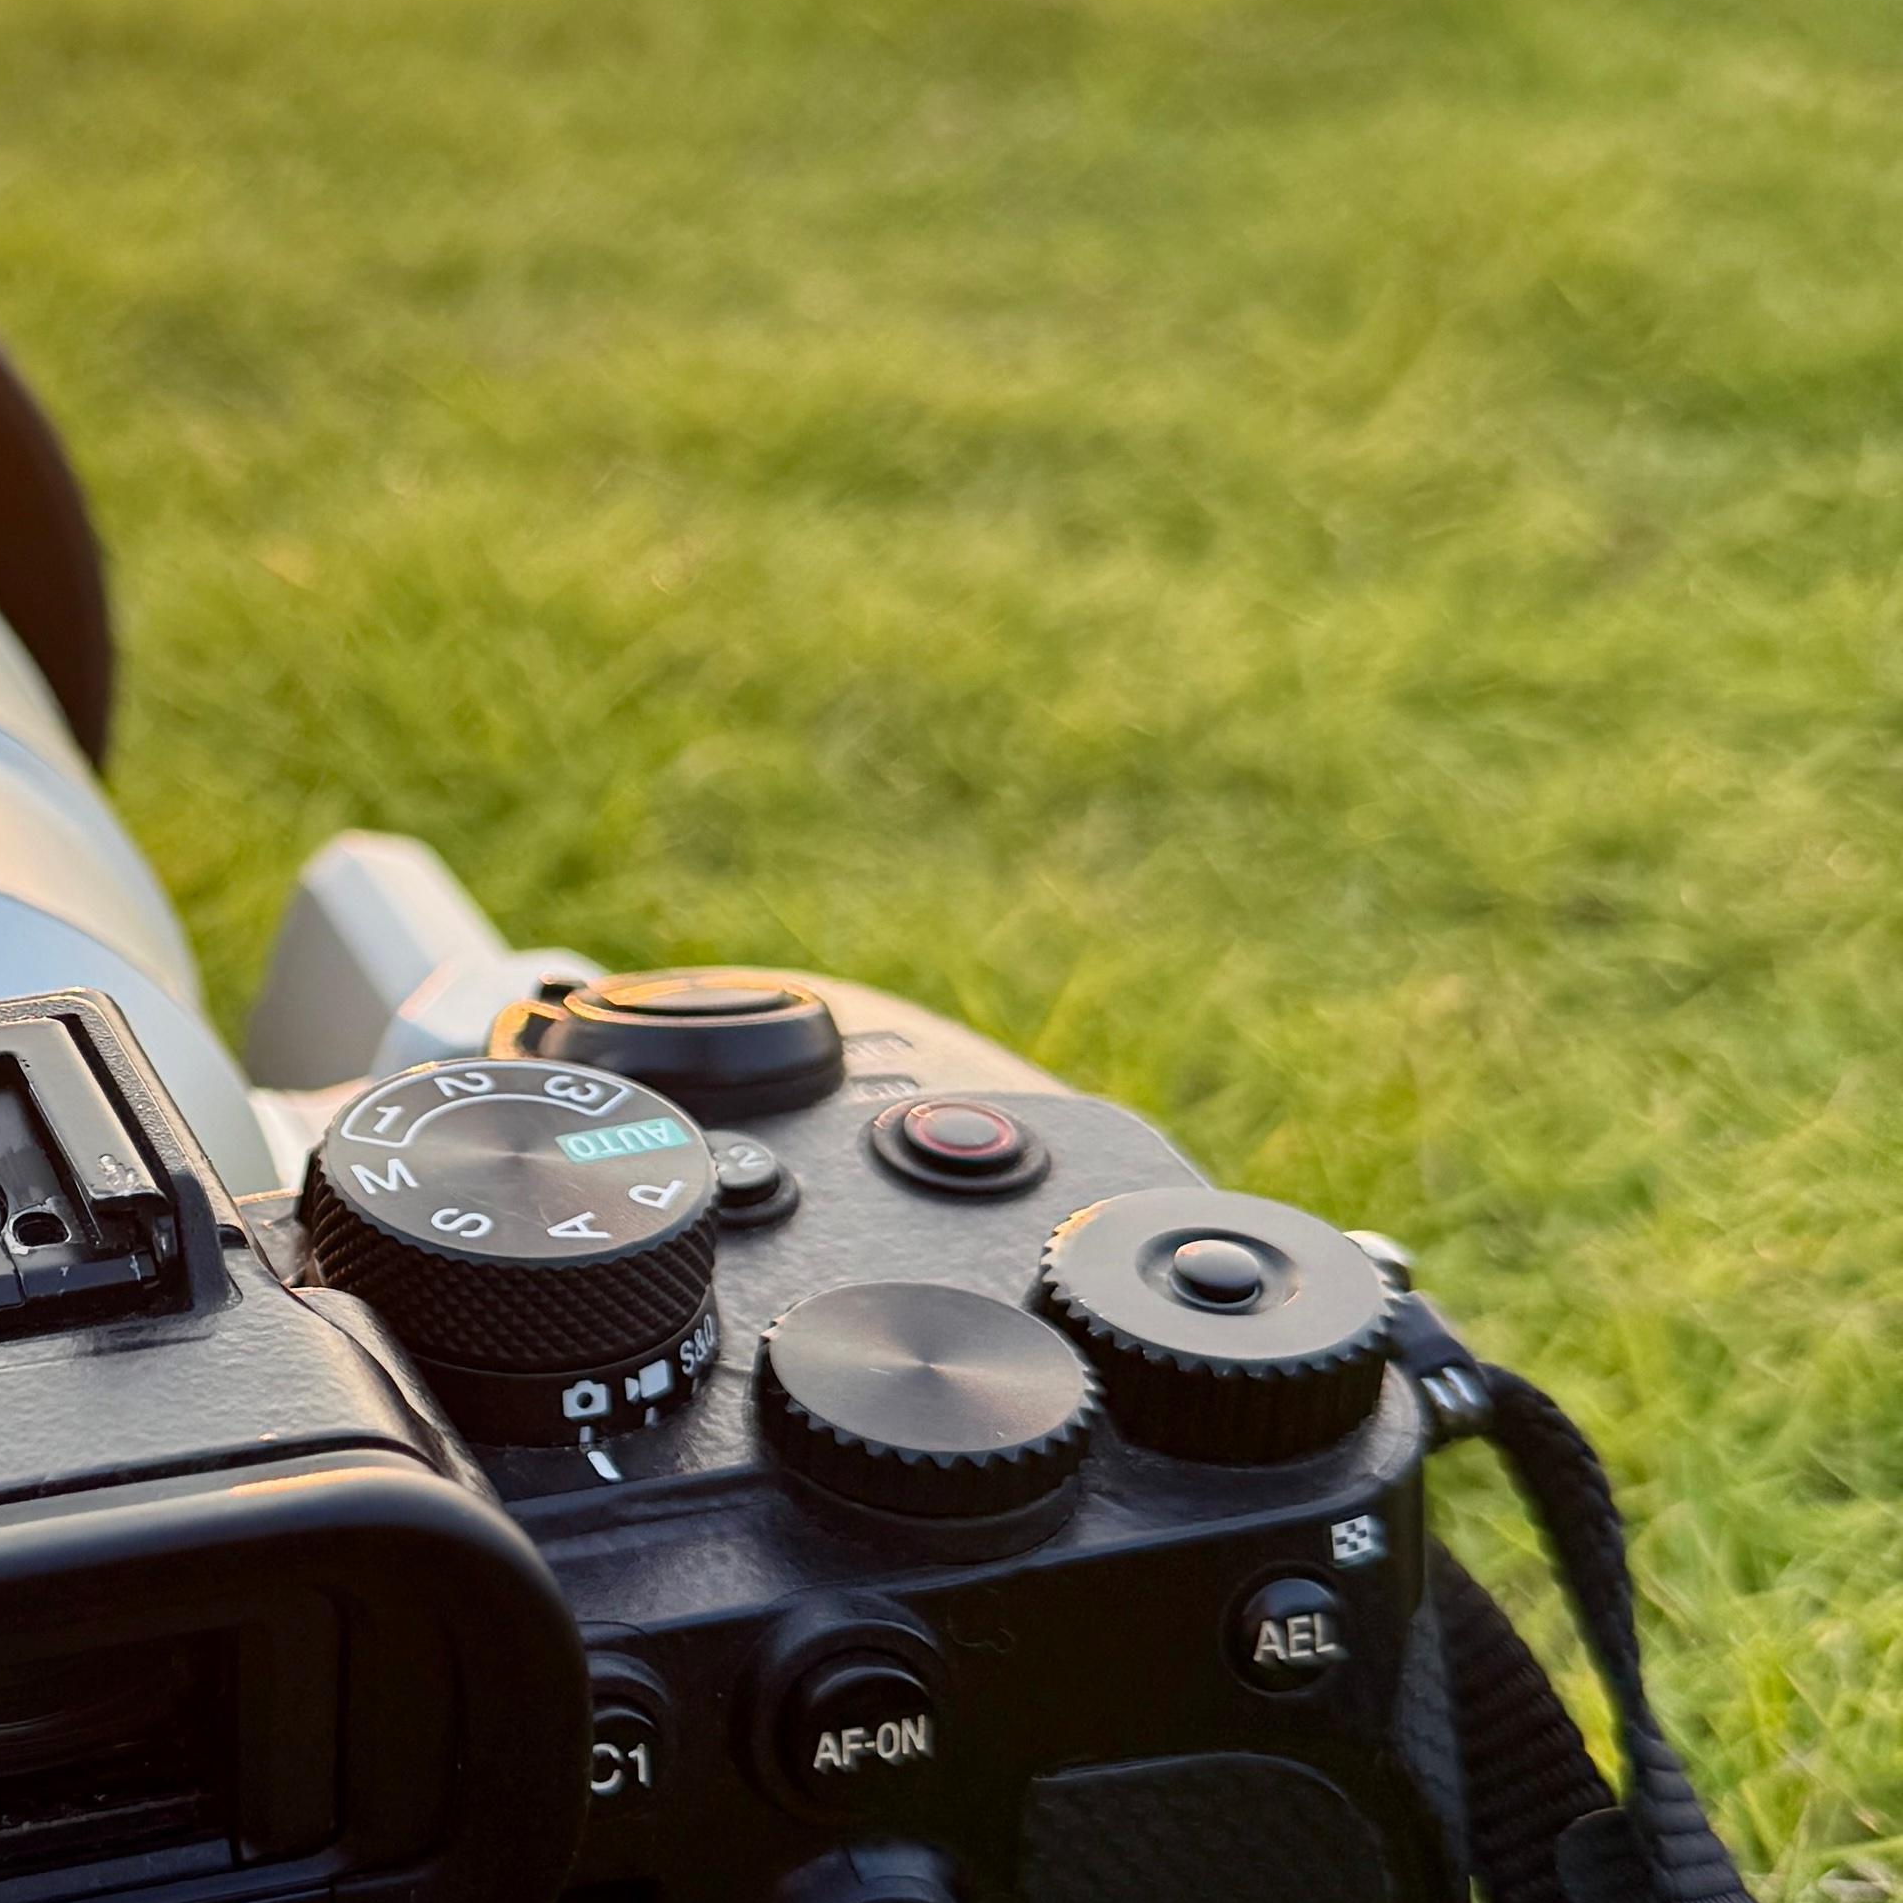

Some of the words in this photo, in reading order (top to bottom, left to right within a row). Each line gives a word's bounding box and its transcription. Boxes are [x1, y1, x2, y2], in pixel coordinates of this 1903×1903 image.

[434, 1070, 494, 1097] 2
[544, 1074, 599, 1103] 3
[374, 1104, 404, 1134] 1
[566, 1121, 671, 1158] AUTO
[350, 1158, 420, 1196] M
[628, 1178, 685, 1210] P
[430, 1207, 493, 1239] S
[546, 1211, 612, 1240] A
[1252, 1611, 1340, 1663] AEL
[813, 1713, 930, 1770] AF-ON
